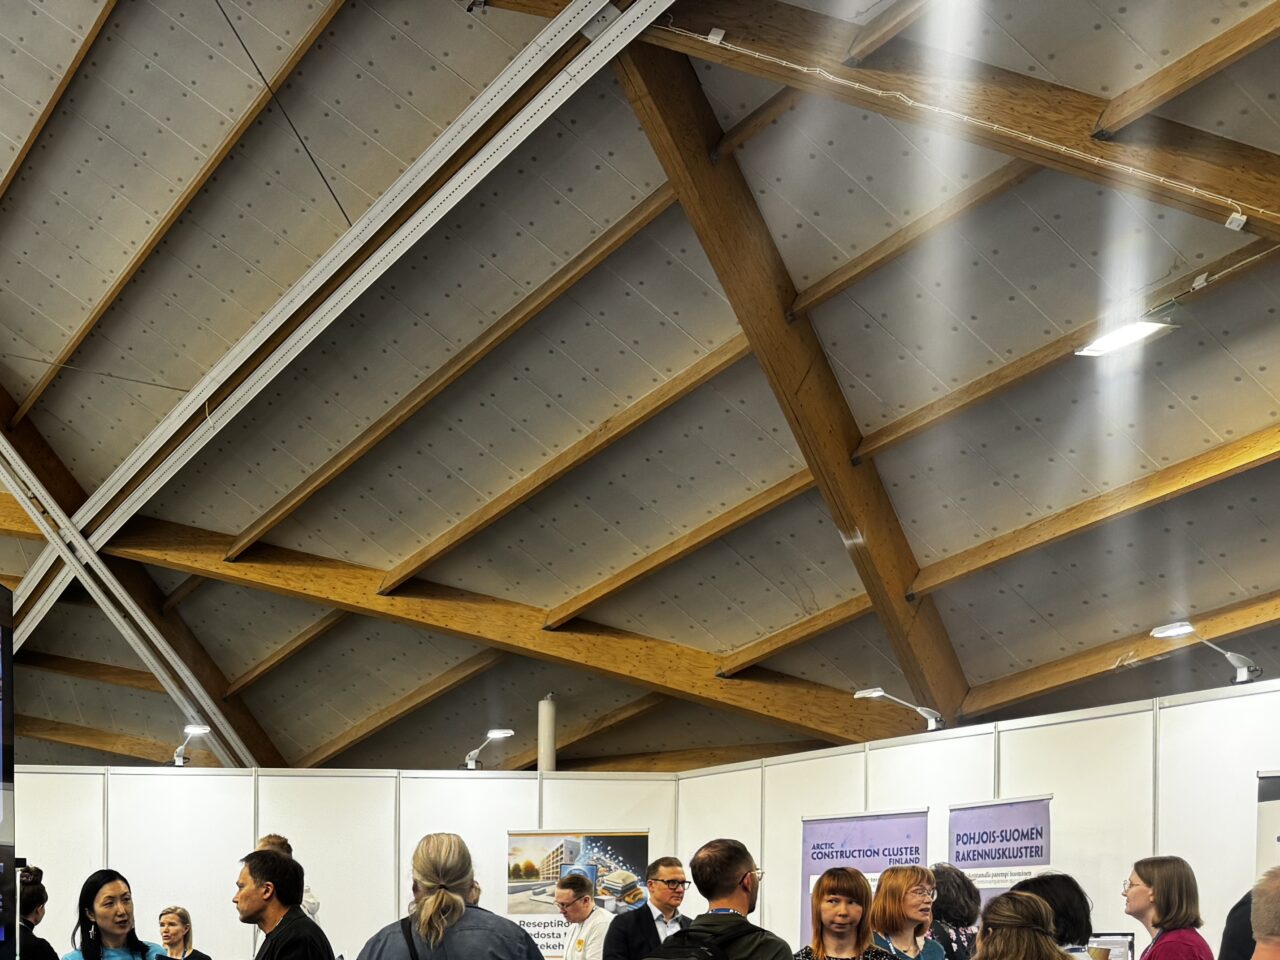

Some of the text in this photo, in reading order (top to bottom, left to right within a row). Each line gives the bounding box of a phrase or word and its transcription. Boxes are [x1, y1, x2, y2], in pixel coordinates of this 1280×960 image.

[955, 826, 1043, 846] POHJOIS-SUOMEN
[811, 842, 835, 850] ARCTIC
[811, 846, 920, 860] CONSTRUCTION CLUSTER
[955, 845, 1043, 862] RAKENNUSKLUSTERI
[888, 857, 920, 865] FINLAND
